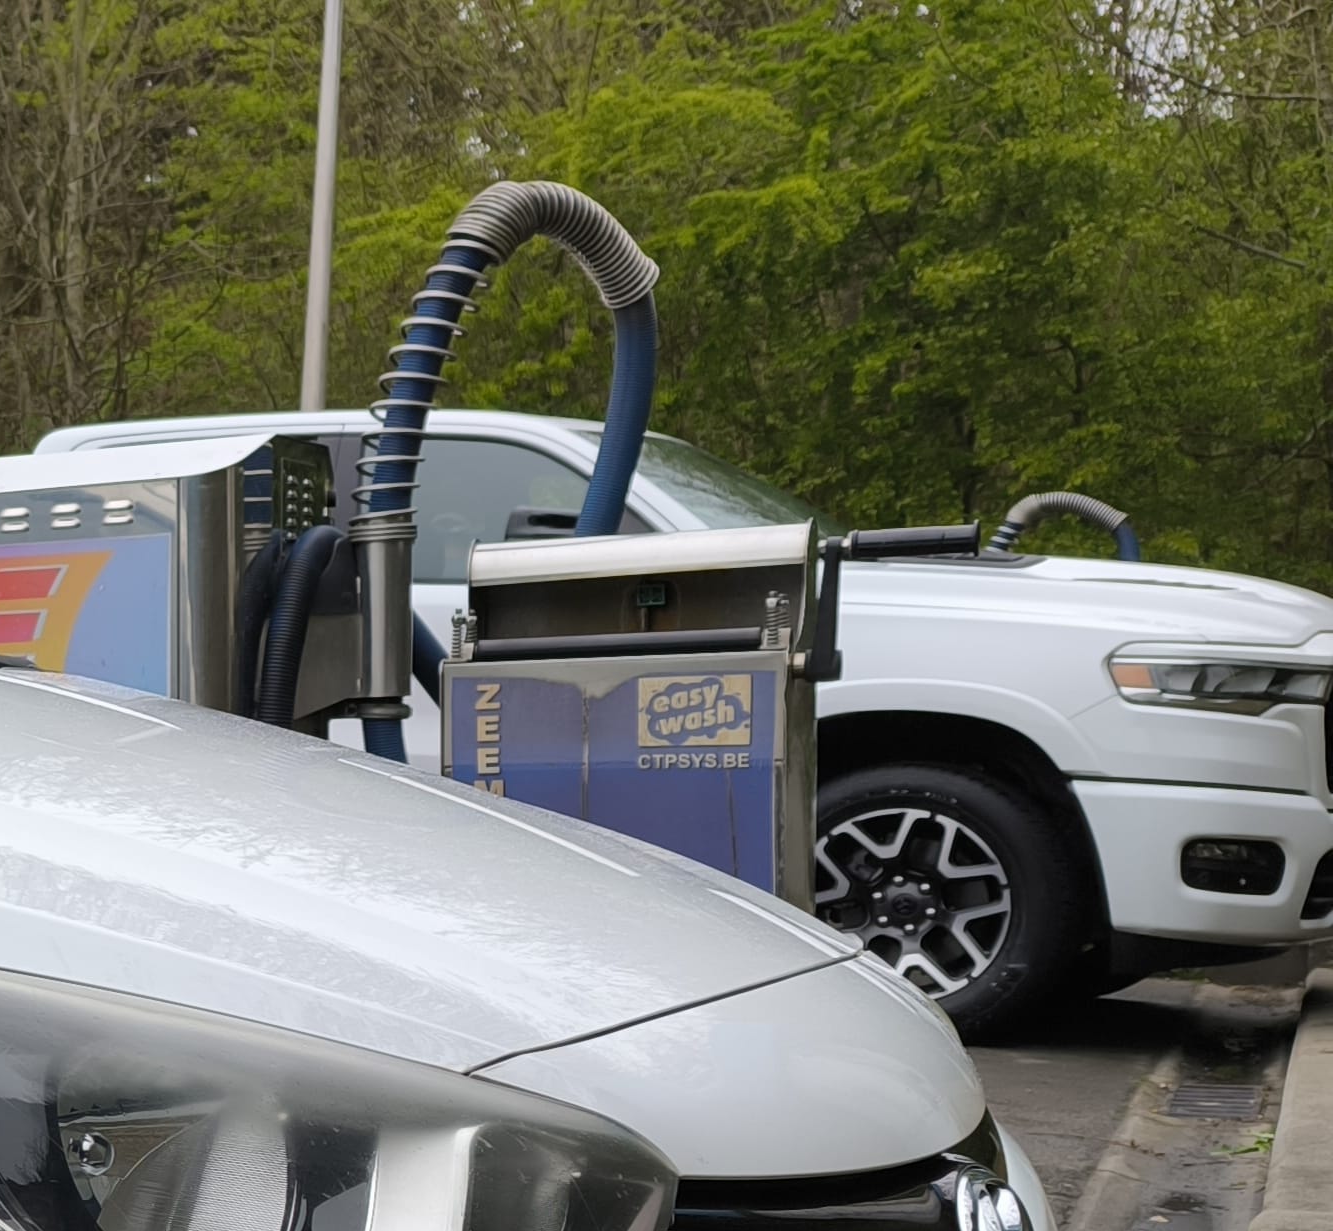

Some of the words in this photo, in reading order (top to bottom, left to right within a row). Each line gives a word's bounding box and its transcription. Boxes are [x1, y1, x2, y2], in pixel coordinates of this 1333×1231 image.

[652, 683, 720, 713] easy
[656, 700, 735, 736] wash
[637, 752, 751, 770] CTPSYS.BE
